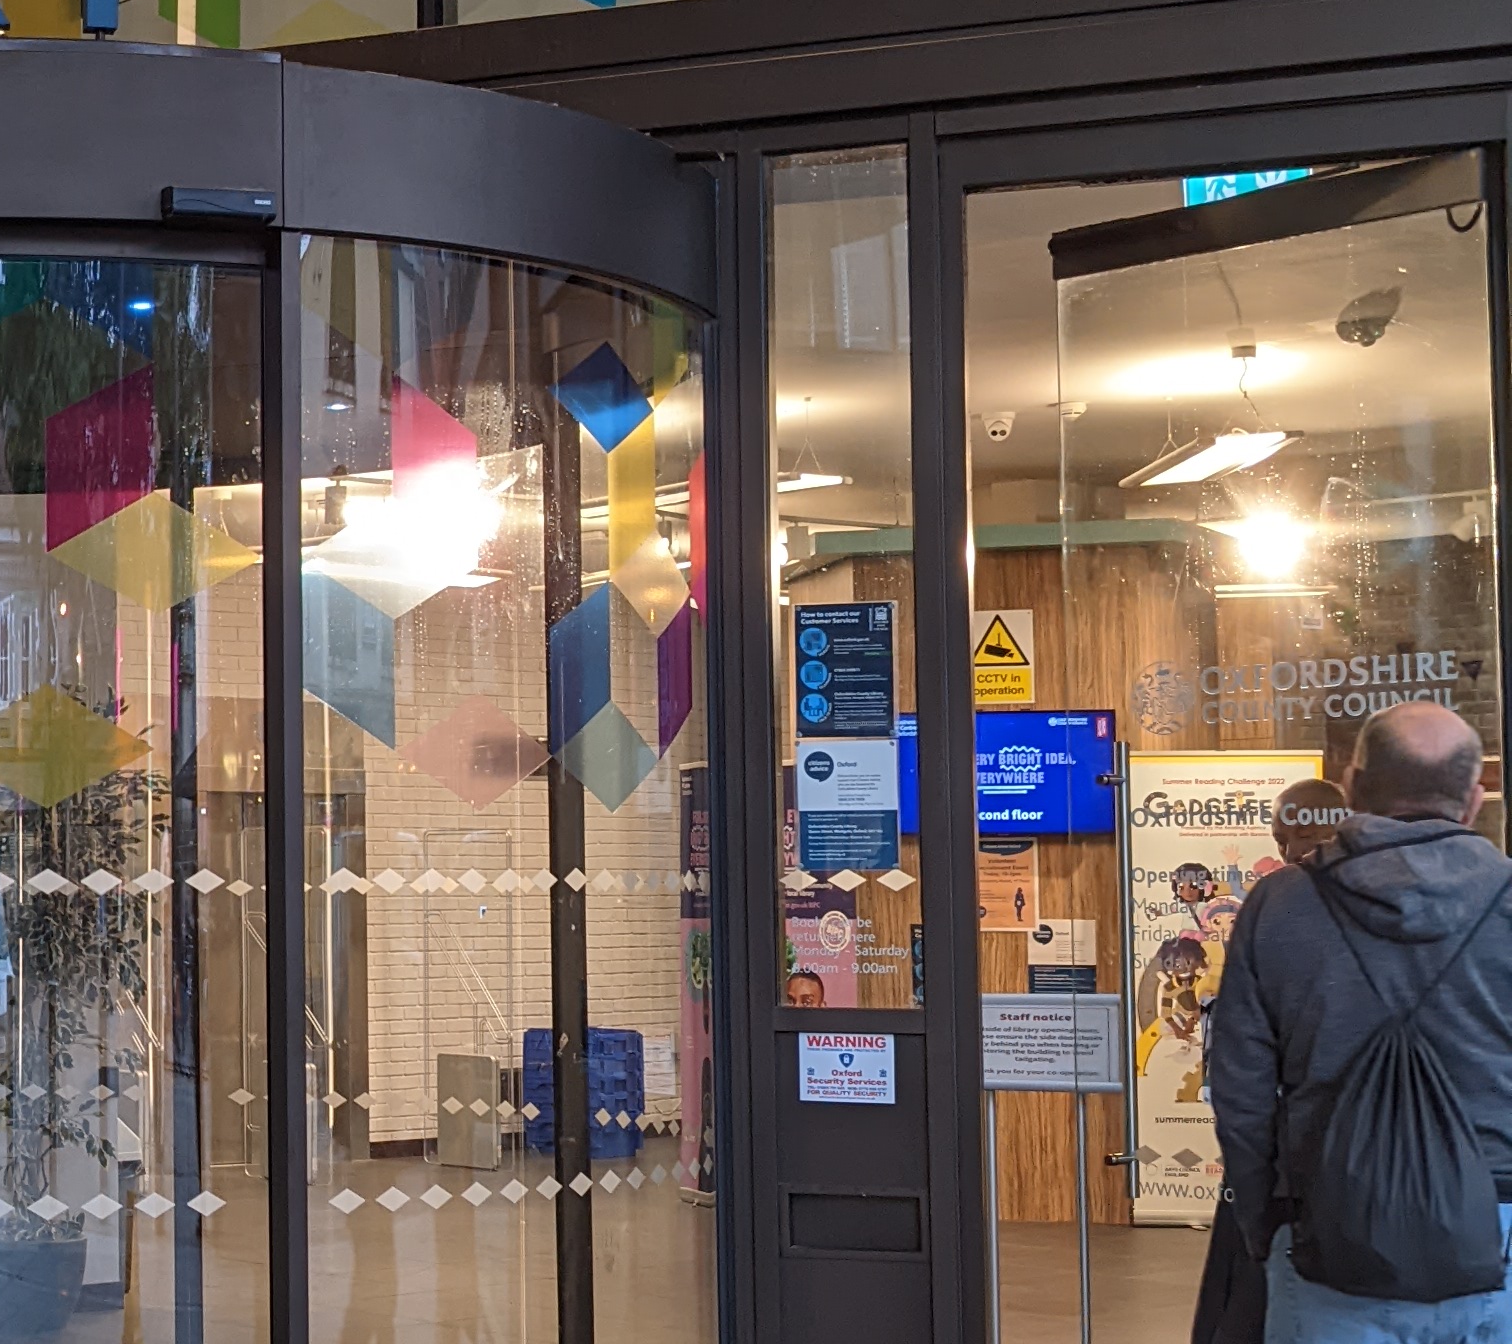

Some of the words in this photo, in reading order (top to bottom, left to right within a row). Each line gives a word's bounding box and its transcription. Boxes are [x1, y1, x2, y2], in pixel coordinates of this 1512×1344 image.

[977, 674, 1008, 682] CCTV
[1010, 674, 1020, 682] in
[1200, 649, 1460, 695] OXFORDSHIRE
[1201, 696, 1320, 724] COUNTY
[998, 752, 1042, 764] BRIGHT
[1194, 778, 1225, 786] Reading
[1227, 778, 1266, 786] Challenge
[1011, 808, 1043, 820] floor
[1130, 806, 1272, 828] Oxfordshire
[1132, 866, 1208, 890] Opening
[857, 916, 872, 928] be
[852, 932, 876, 942] here
[791, 946, 841, 960] Monday
[854, 944, 909, 960] Saturday
[851, 962, 898, 974] 9.00am
[1000, 1013, 1030, 1021] Staff
[1032, 1013, 1072, 1021] notice
[806, 1035, 886, 1048] WARNING
[807, 1077, 845, 1086] Security
[847, 1078, 887, 1086] Services
